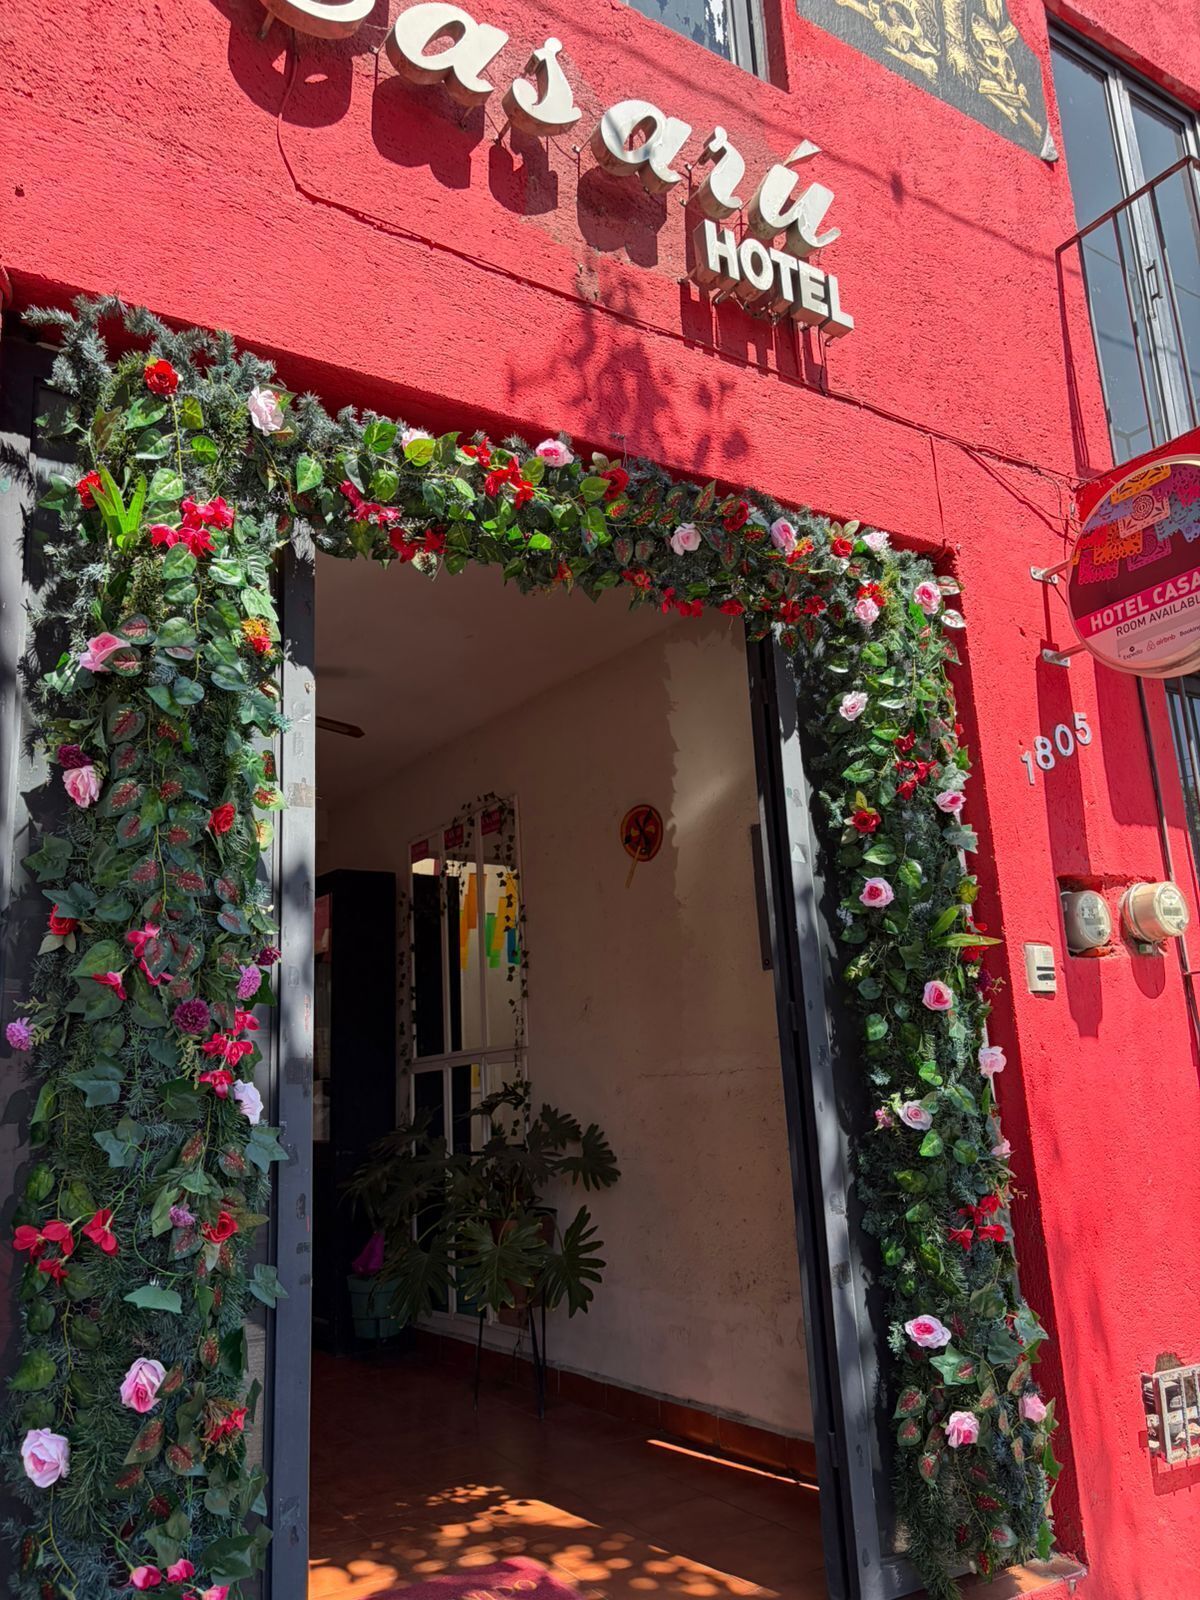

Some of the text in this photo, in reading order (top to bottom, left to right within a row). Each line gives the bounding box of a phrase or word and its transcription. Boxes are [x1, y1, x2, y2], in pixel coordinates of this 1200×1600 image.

[275, 0, 842, 248] asarú
[703, 218, 855, 330] HOTEL
[1090, 595, 1149, 632] HOTEL
[1115, 616, 1147, 637] ROOM
[1156, 634, 1176, 646] airbnb
[1020, 712, 1093, 786] 1805
